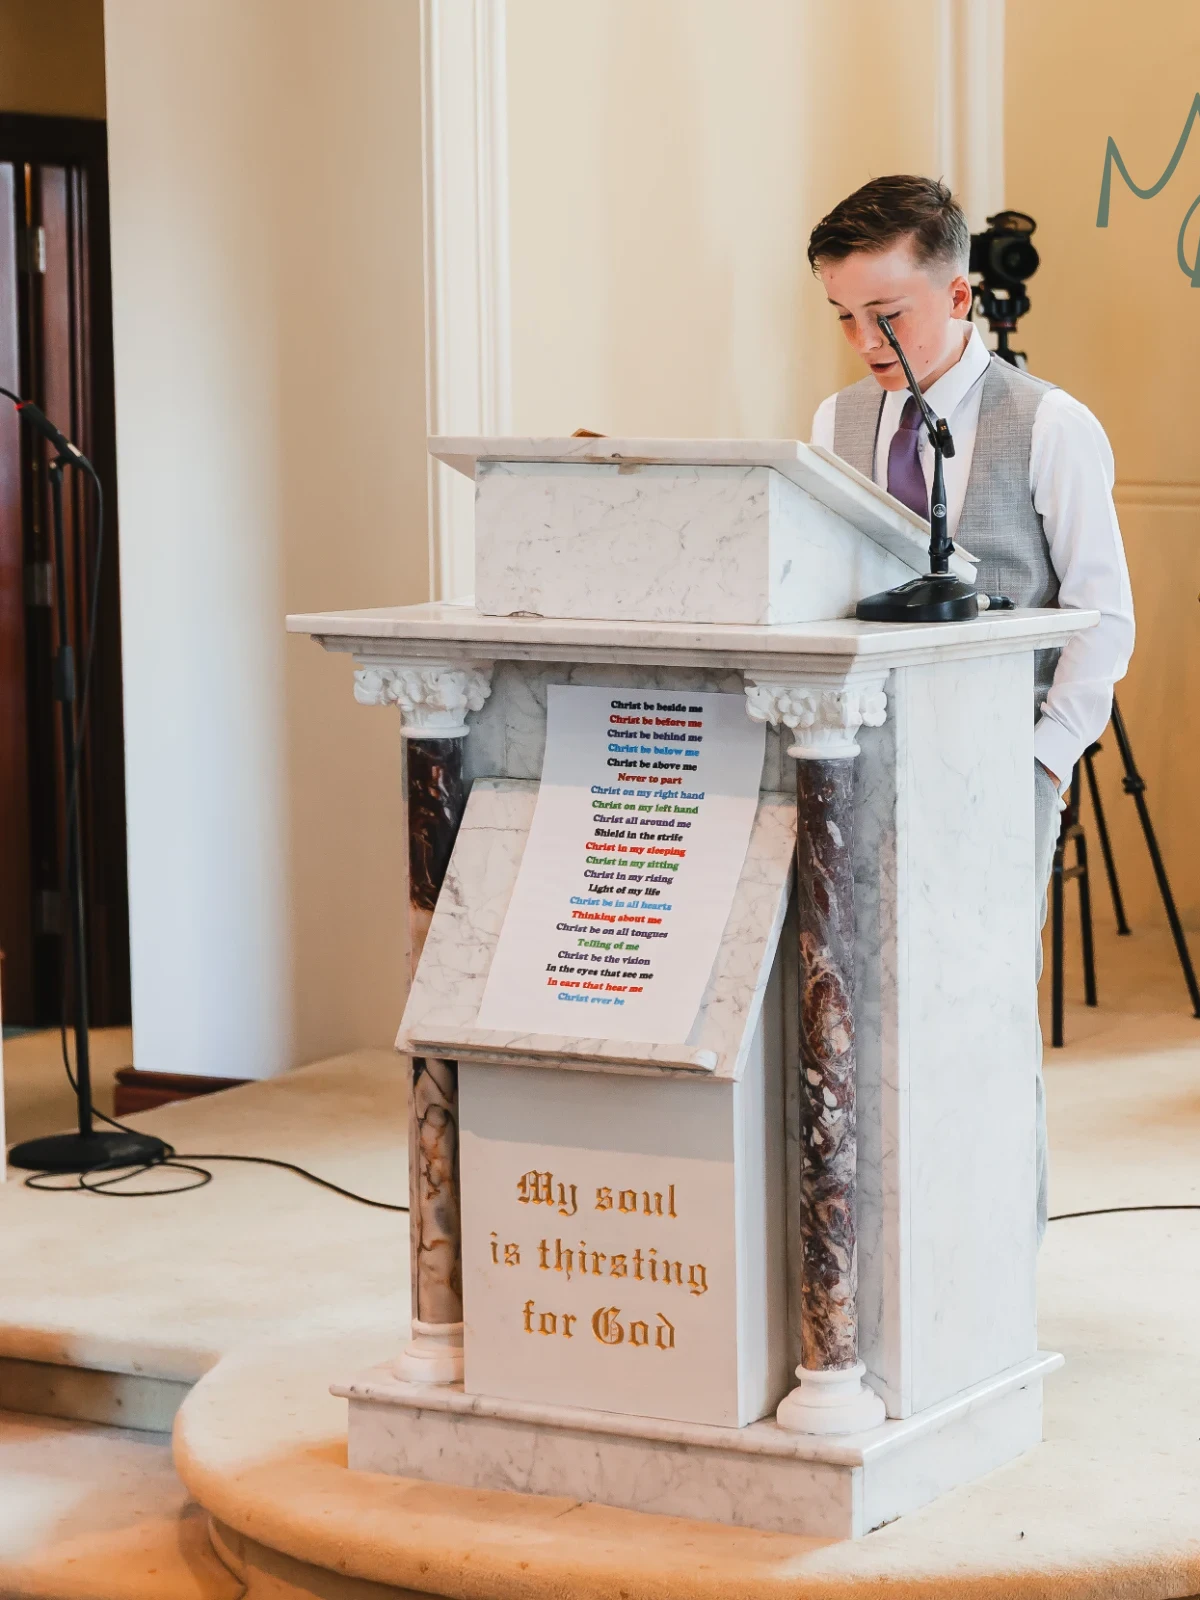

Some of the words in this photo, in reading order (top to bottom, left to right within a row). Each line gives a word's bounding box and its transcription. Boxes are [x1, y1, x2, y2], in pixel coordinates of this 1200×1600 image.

[611, 701, 641, 709] Christ
[644, 702, 654, 710] be
[656, 703, 686, 712] beside
[610, 715, 640, 724] Christ
[642, 717, 653, 725] be
[656, 717, 686, 727] before
[607, 729, 637, 738] Christ
[640, 731, 650, 739] be
[653, 732, 686, 741] behind
[608, 743, 638, 753] Christ
[640, 746, 651, 754] be
[607, 758, 637, 767] Christ
[639, 760, 650, 768] be
[652, 761, 680, 770] above
[618, 773, 647, 782] Never
[660, 777, 682, 785] part
[591, 785, 620, 795] Christ
[637, 790, 652, 798] my
[654, 790, 678, 800] right
[680, 791, 704, 799] hand
[592, 800, 622, 809] Christ
[638, 805, 653, 813] my
[655, 804, 672, 812] left
[674, 805, 698, 814] hand
[593, 814, 624, 823] Christ
[640, 819, 675, 827] around
[594, 828, 625, 838] Shield
[627, 831, 636, 839] in
[640, 832, 655, 840] the
[657, 834, 683, 842] strife
[586, 842, 616, 851] Christ
[618, 844, 628, 852] in
[629, 847, 645, 855] my
[586, 856, 616, 865] Christ
[630, 861, 645, 869] my
[647, 861, 679, 871] sitting
[584, 869, 614, 879] Christ
[616, 872, 626, 880] in
[645, 874, 674, 885] rising
[588, 884, 614, 894] Light
[616, 886, 627, 894] of
[644, 888, 660, 896] life
[570, 896, 600, 905] Christ
[641, 901, 672, 910] hearts
[572, 911, 616, 923] Thinking
[618, 914, 646, 923] about
[556, 923, 588, 932] Christ
[589, 926, 600, 934] be
[616, 928, 629, 936] all
[631, 929, 668, 939] tongues
[578, 939, 612, 950] Telling
[558, 951, 589, 960] Christ
[591, 954, 602, 962] be
[604, 955, 620, 963] the
[622, 956, 650, 965] vision
[546, 964, 556, 972] In
[559, 965, 574, 973] the
[600, 969, 621, 977] that
[547, 977, 558, 985] In
[583, 982, 604, 990] that
[605, 983, 628, 992] hear
[558, 993, 588, 1002] Christ
[516, 1169, 579, 1217] My
[595, 1183, 678, 1219] soul
[489, 1231, 521, 1267] is
[538, 1238, 709, 1297] thirsting
[522, 1299, 577, 1339] for
[591, 1305, 676, 1351] God
